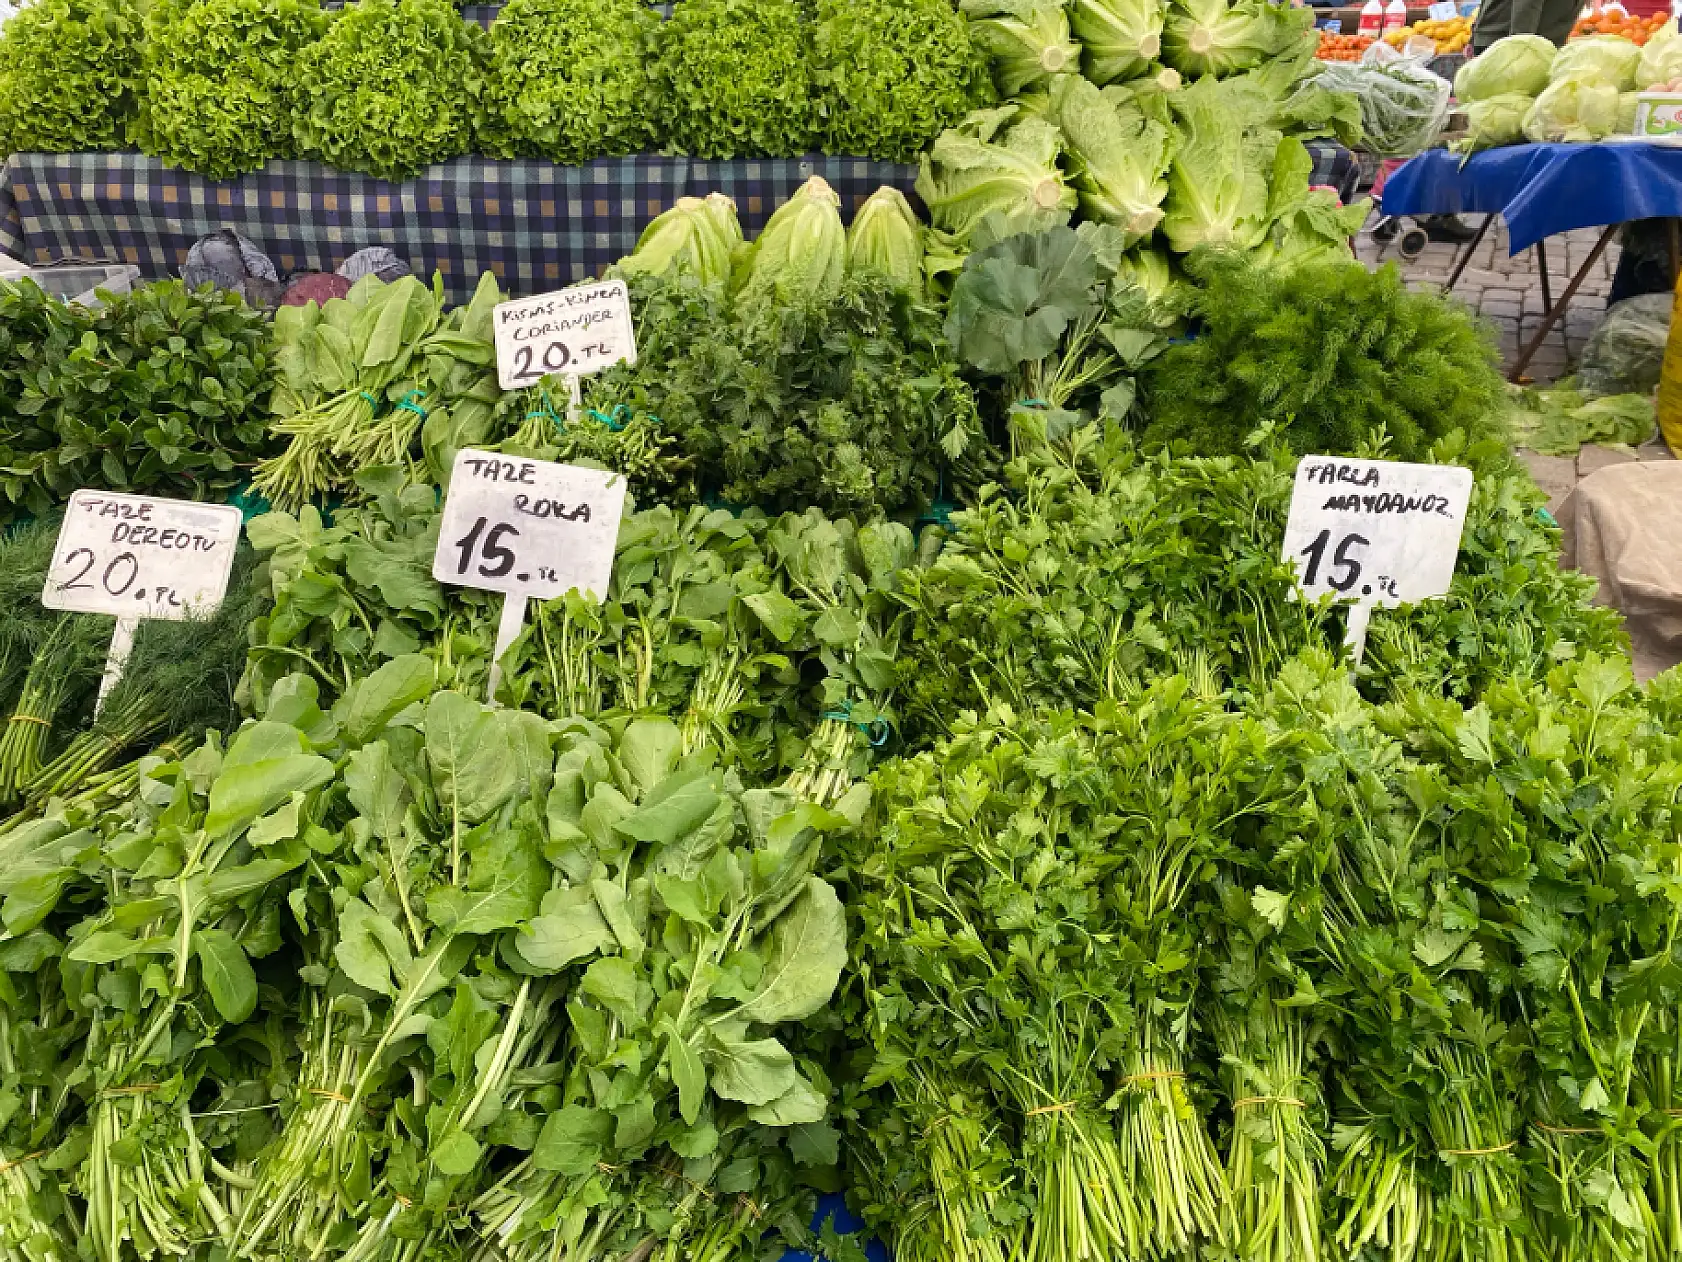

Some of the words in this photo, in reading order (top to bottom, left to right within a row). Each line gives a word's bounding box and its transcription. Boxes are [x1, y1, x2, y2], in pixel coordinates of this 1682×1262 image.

[581, 342, 611, 358] TL
[464, 459, 536, 484] TAZE
[1305, 463, 1380, 487] TARLA
[77, 499, 154, 521] TAZE
[513, 494, 592, 523] ROKA
